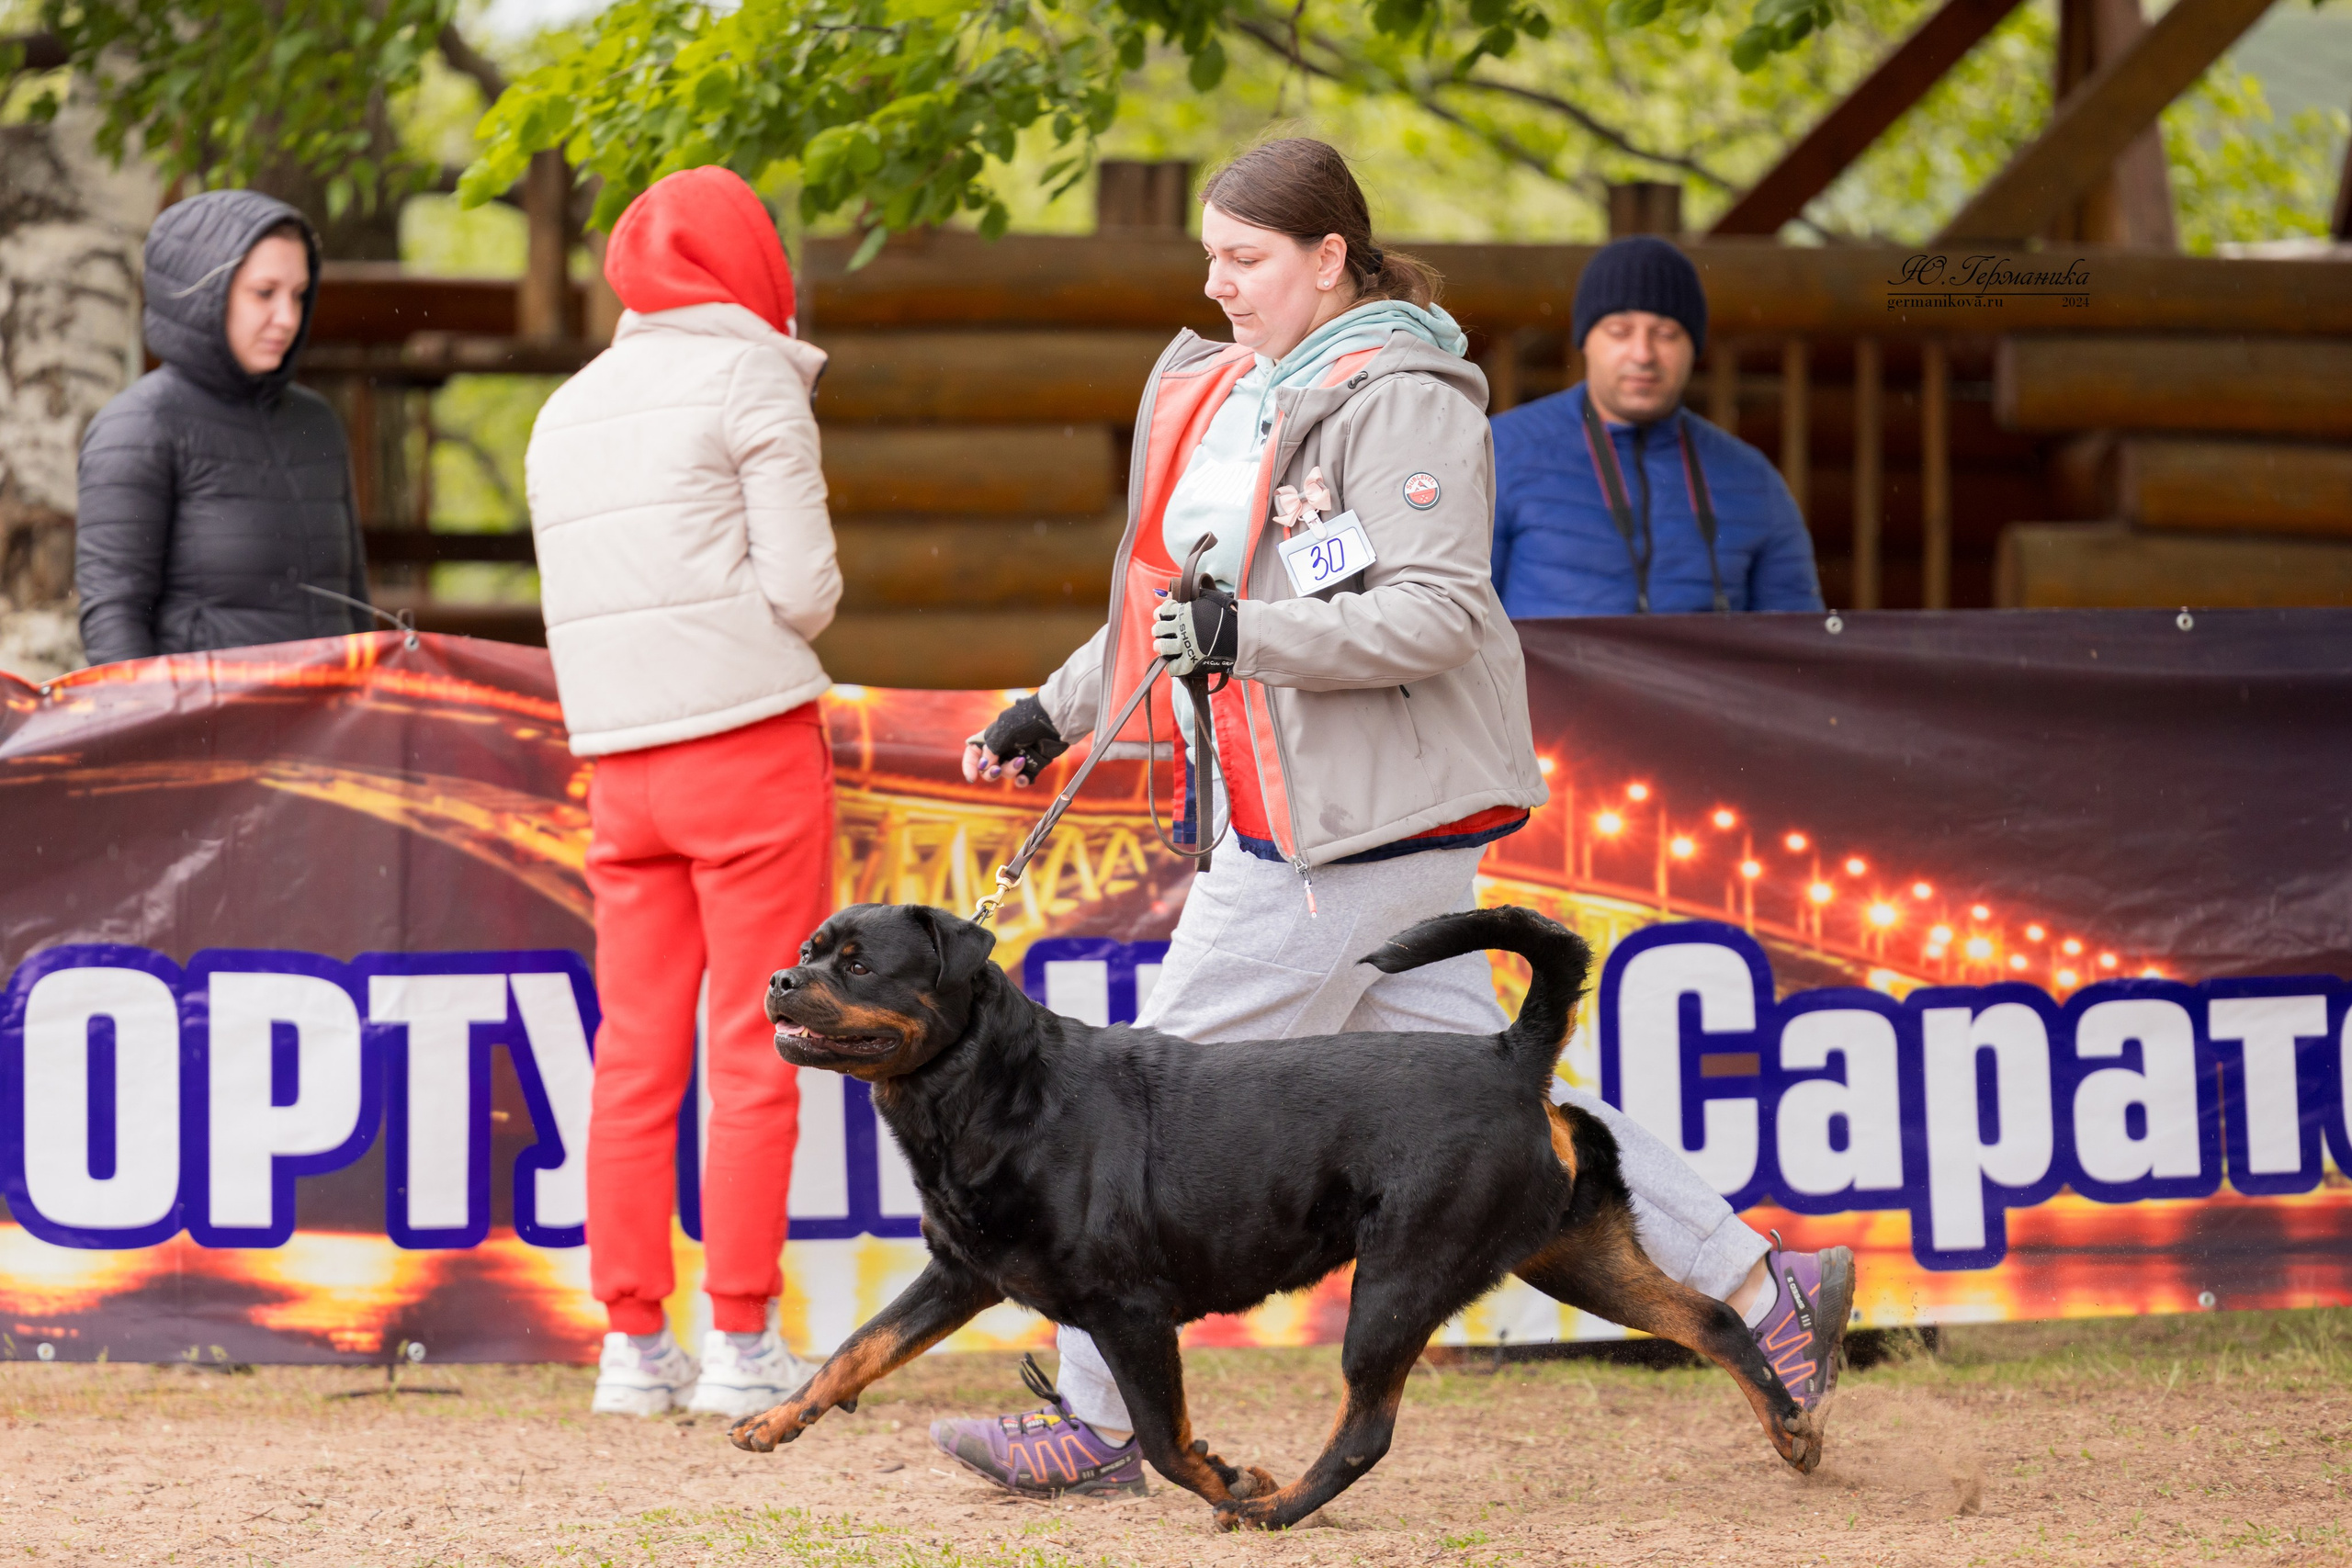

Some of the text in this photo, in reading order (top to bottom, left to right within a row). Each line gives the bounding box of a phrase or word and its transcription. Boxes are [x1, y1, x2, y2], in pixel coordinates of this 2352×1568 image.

[1406, 474, 1435, 490] SUBLEVEL
[1310, 537, 1345, 581] 30
[1179, 623, 1199, 664] SHOCK
[1618, 942, 2352, 1250] Сарат
[1790, 1282, 1805, 1310] SPEED
